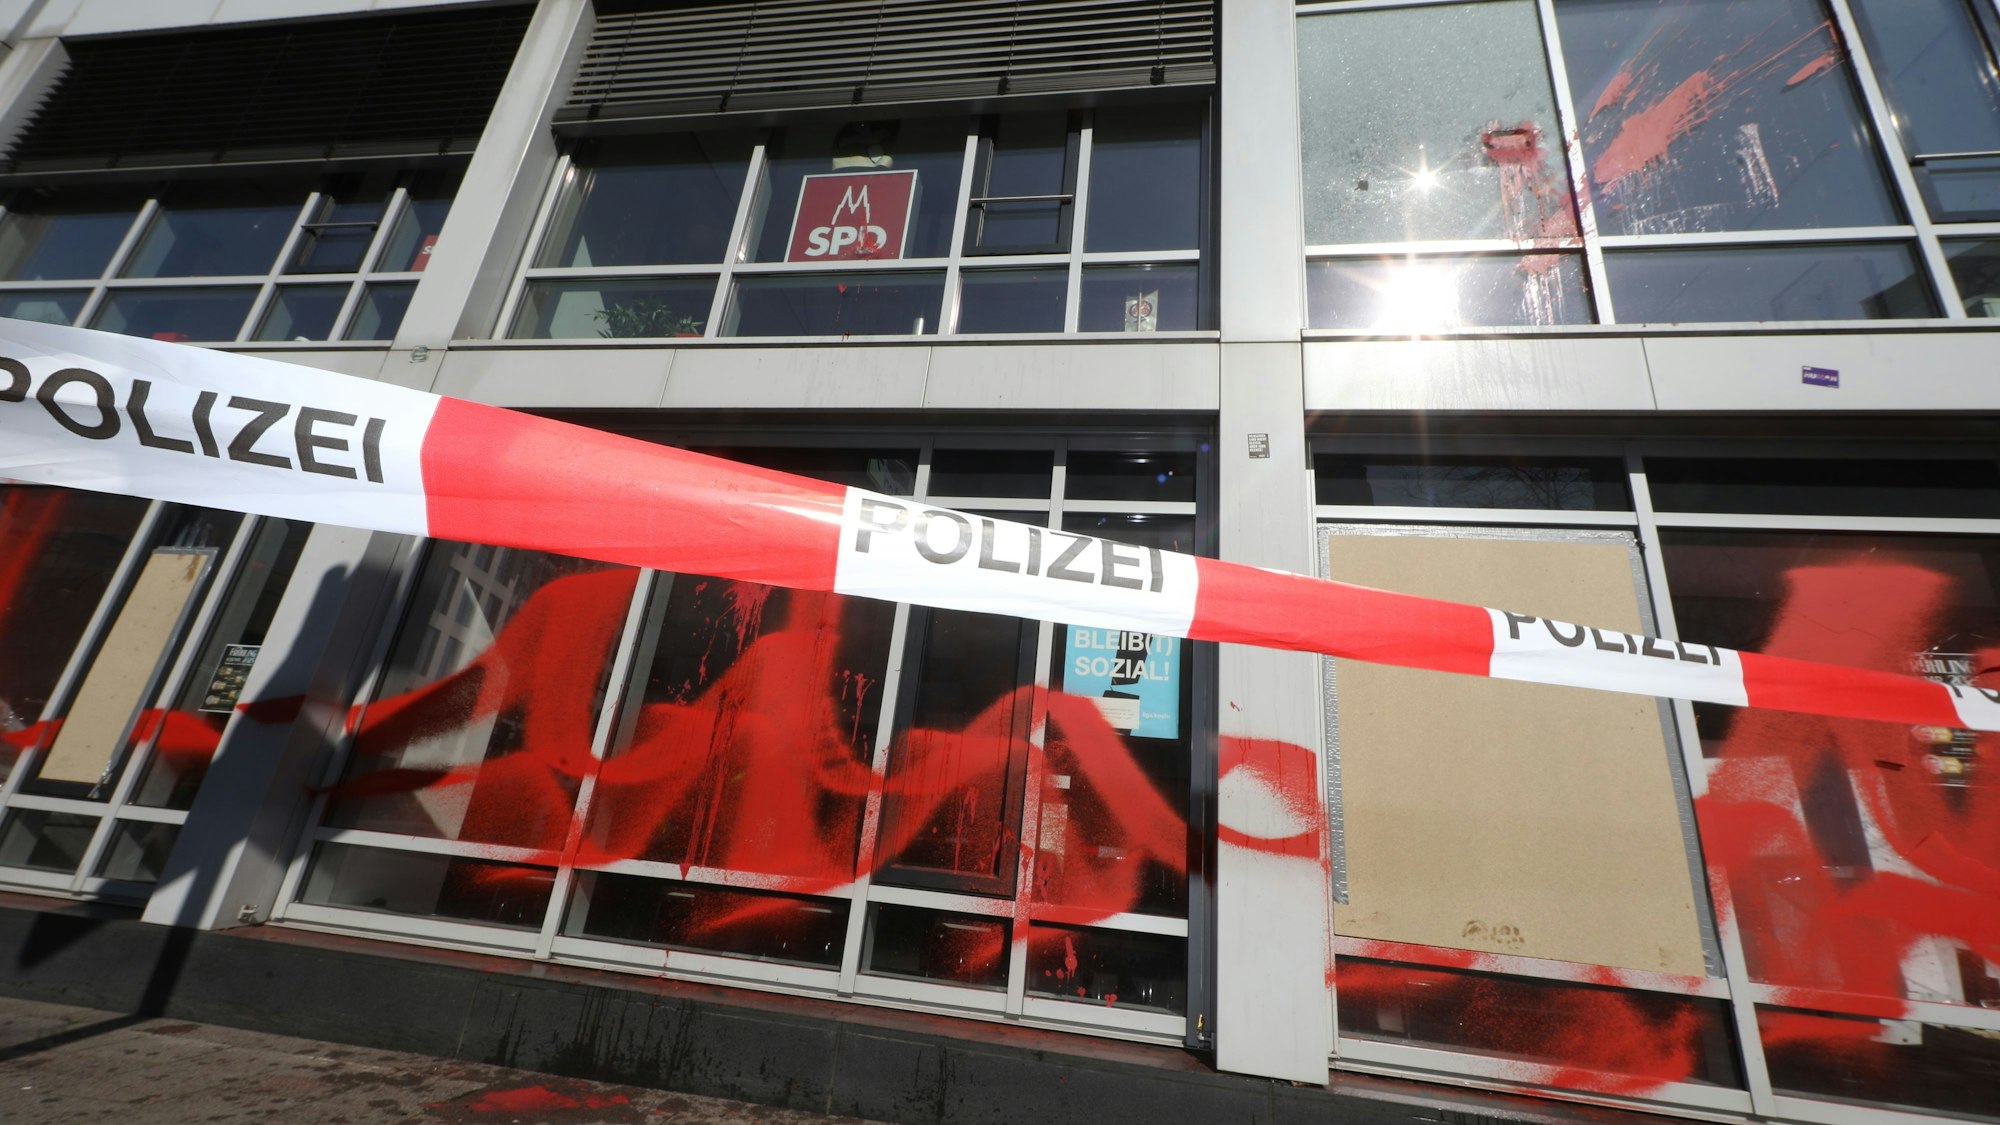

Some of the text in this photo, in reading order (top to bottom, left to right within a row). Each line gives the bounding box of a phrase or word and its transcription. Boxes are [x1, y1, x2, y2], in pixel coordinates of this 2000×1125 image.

[805, 224, 888, 258] SPD
[855, 498, 1163, 593] POLIZEI
[1074, 629, 1173, 657] BLEIB(T)
[1074, 655, 1170, 681] SOZIAL!
